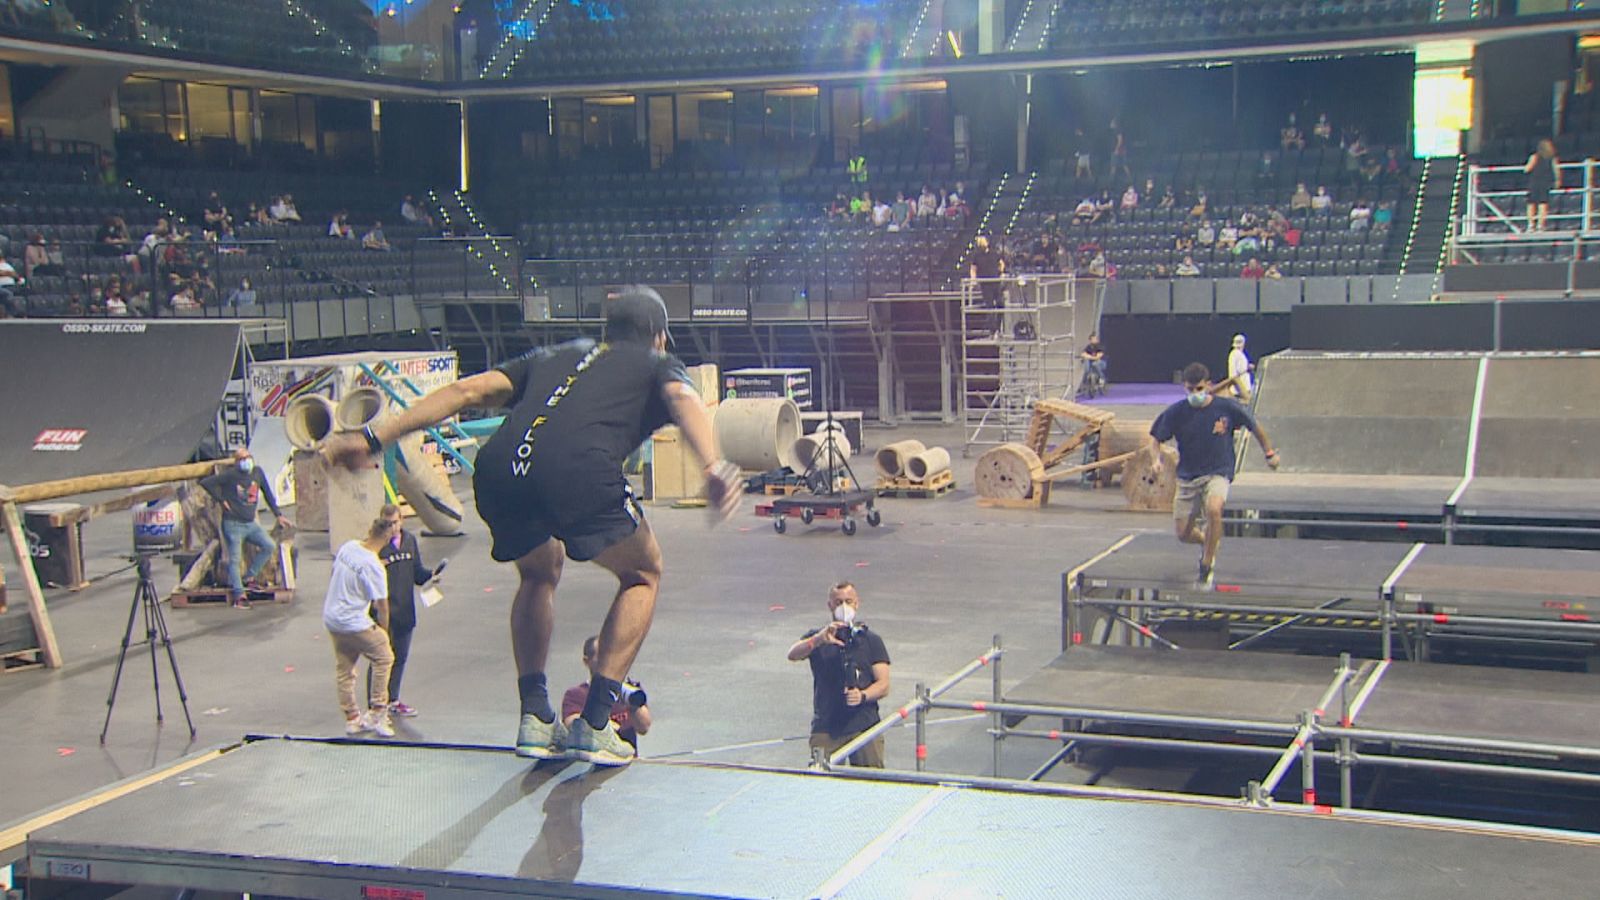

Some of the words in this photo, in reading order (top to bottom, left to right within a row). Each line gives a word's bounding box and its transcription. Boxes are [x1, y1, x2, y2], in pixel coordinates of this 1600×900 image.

[62, 323, 147, 333] OSSO-SKATE.COM
[399, 357, 454, 375] INTERSPORT
[39, 430, 87, 442] FUN
